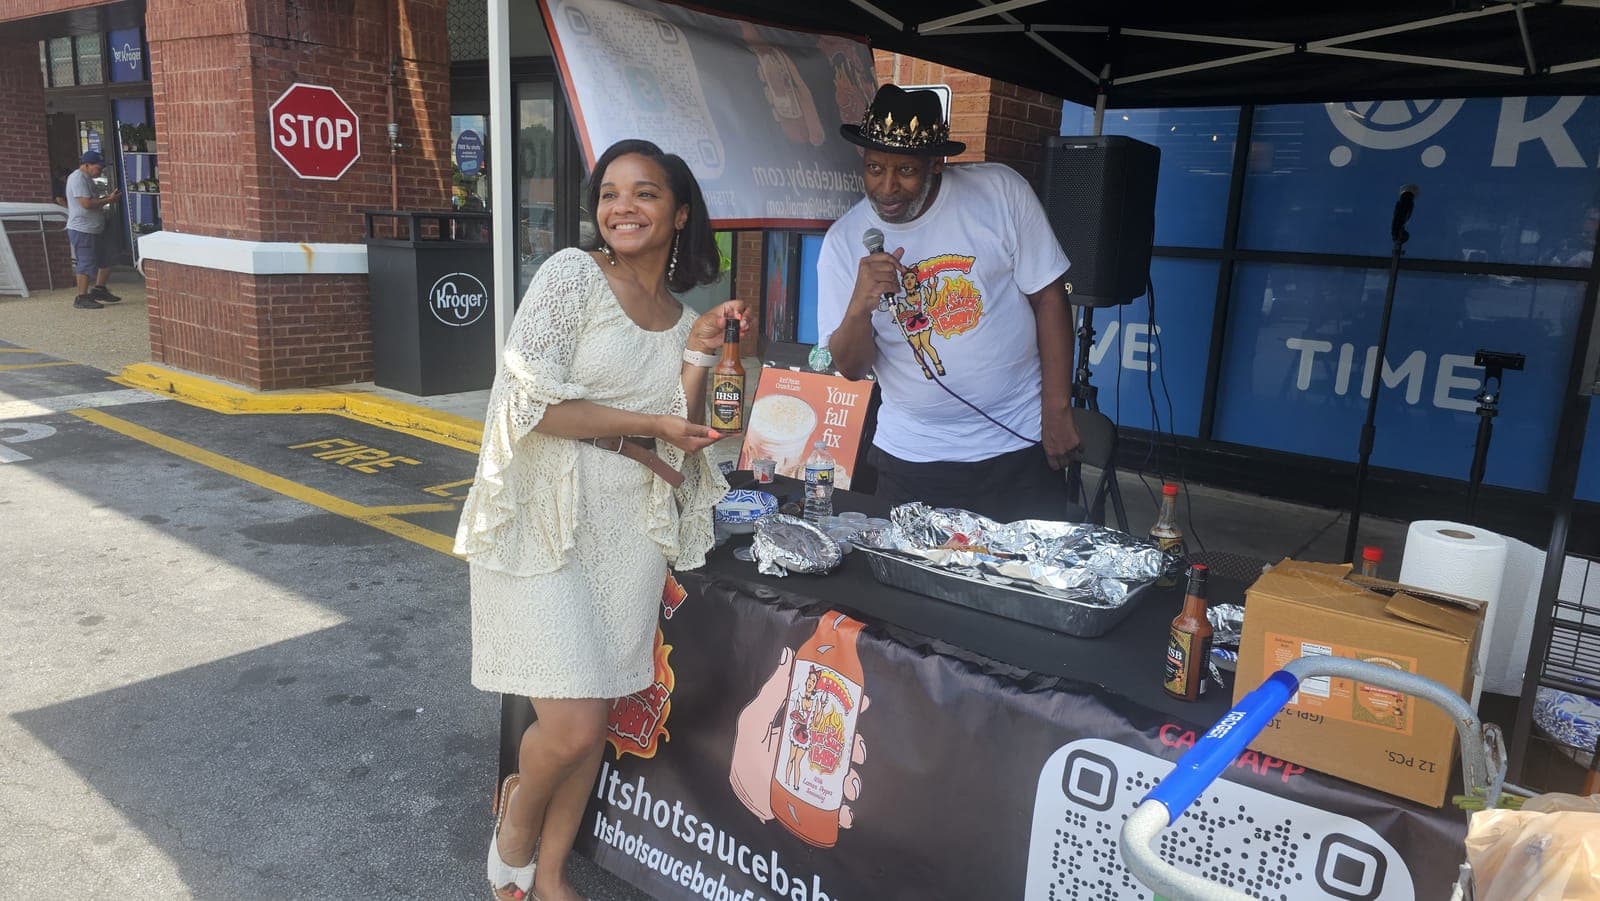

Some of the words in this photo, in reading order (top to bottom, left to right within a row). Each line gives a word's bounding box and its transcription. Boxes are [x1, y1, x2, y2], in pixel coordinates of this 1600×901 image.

[279, 114, 353, 151] STOP
[436, 282, 482, 319] Kroger
[1089, 320, 1162, 372] VE
[1286, 337, 1482, 413] TIME
[715, 391, 740, 401] IHSB
[826, 386, 859, 407] Your
[824, 407, 849, 428] fall
[822, 428, 842, 449] fix
[288, 438, 423, 474] FIRE
[1205, 711, 1247, 739] KROGER
[1158, 723, 1306, 784] CAAPP
[1384, 749, 1415, 768] PCS.
[1419, 759, 1437, 774] 12
[597, 761, 838, 901] Itshotsaucebab
